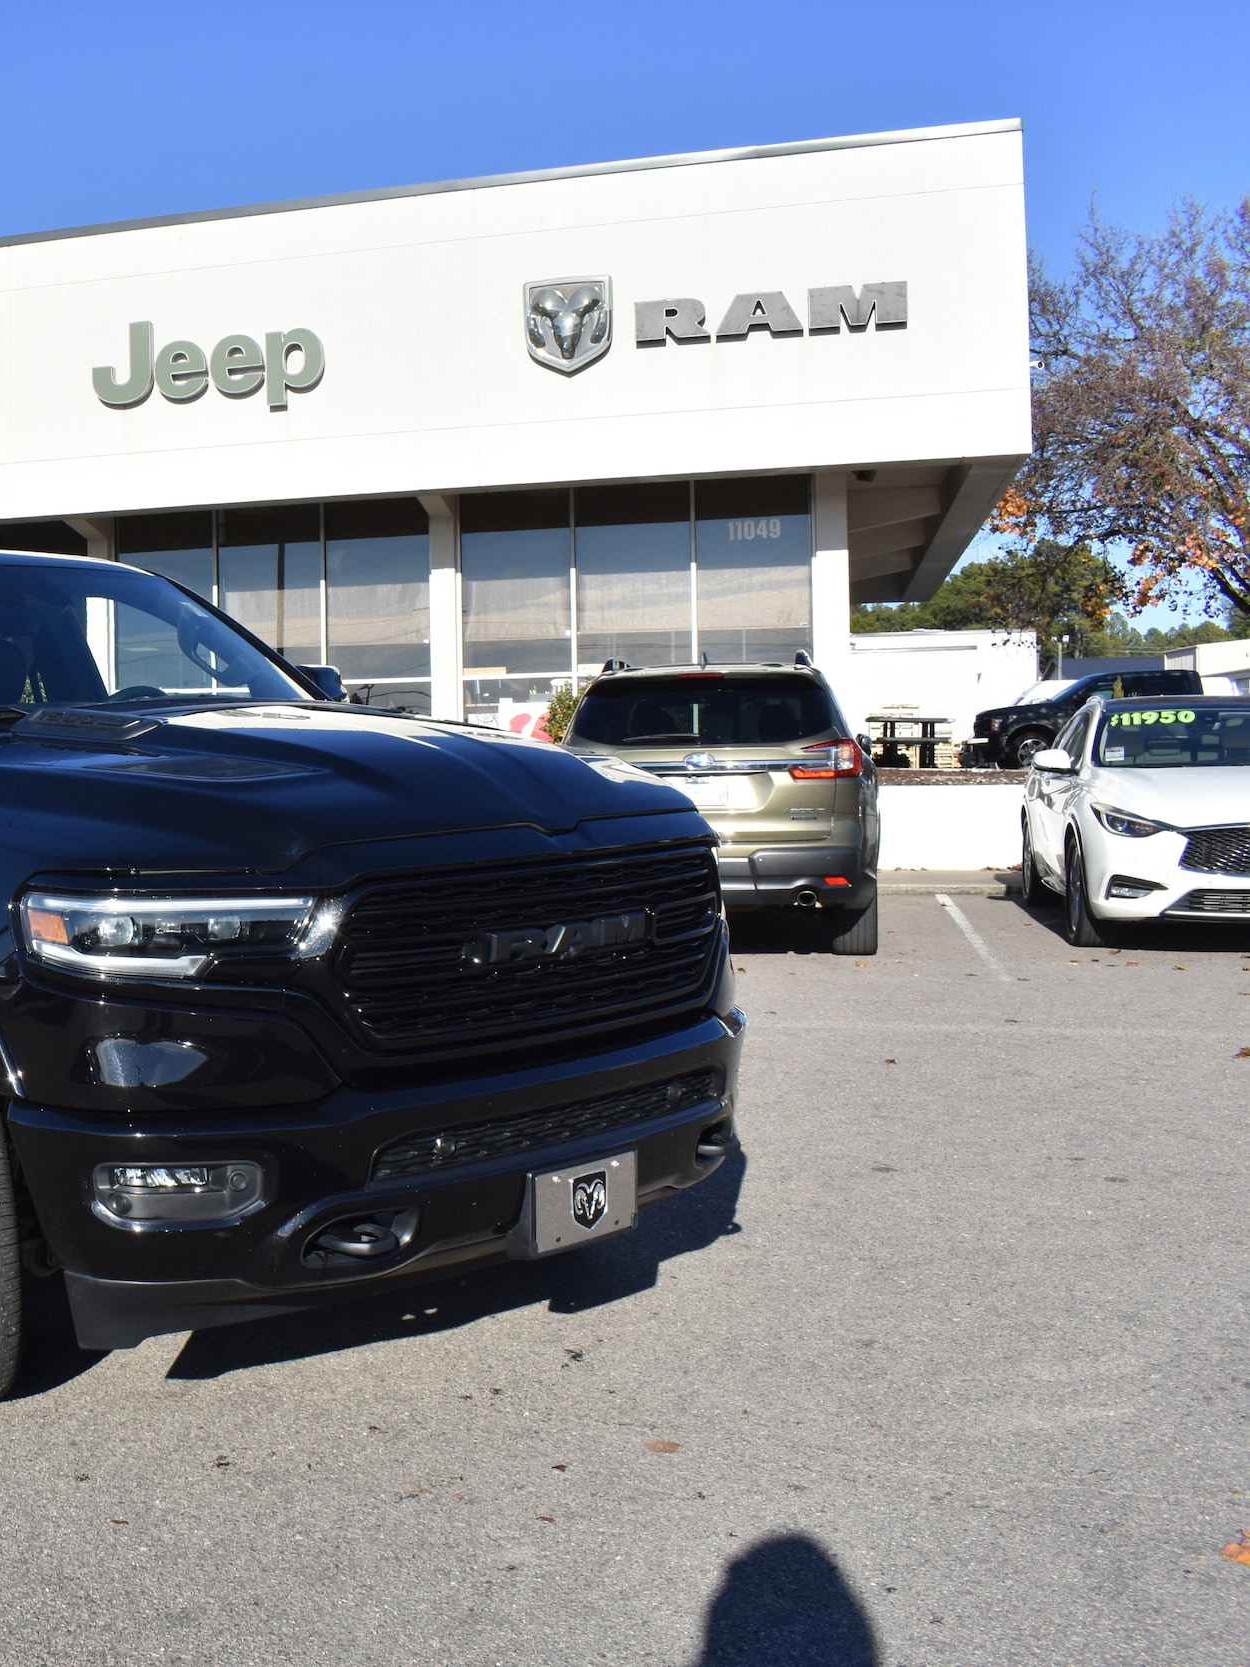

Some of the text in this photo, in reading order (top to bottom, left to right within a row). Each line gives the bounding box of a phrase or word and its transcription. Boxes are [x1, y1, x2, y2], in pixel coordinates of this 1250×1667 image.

[634, 280, 908, 349] RAM
[92, 320, 325, 411] Jeep
[727, 518, 782, 541] 11049
[1110, 710, 1196, 727] $11950
[485, 911, 646, 963] RAM
